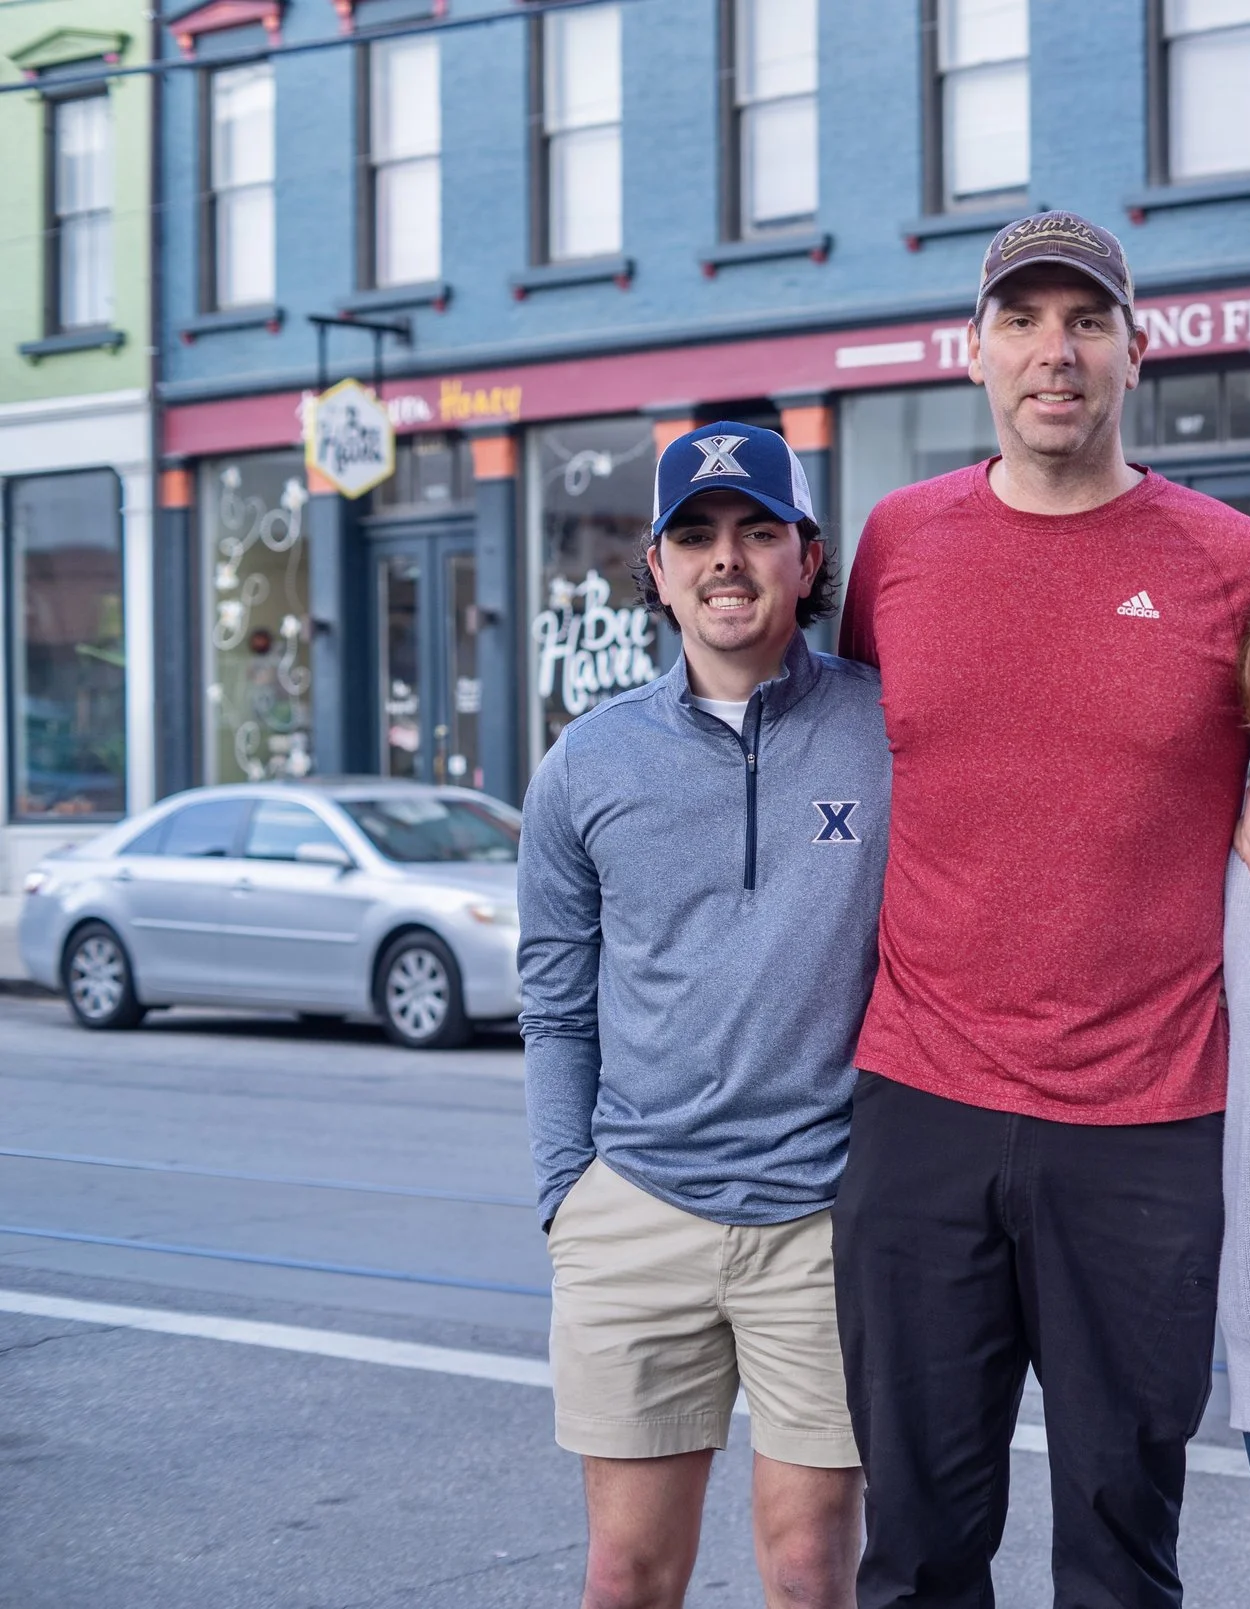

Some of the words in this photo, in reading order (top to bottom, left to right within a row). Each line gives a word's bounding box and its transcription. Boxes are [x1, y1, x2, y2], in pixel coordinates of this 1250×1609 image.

[690, 435, 751, 482] X
[574, 569, 655, 650] Bee
[1117, 606, 1160, 619] adidas
[532, 610, 661, 715] Haven
[811, 801, 862, 843] X
